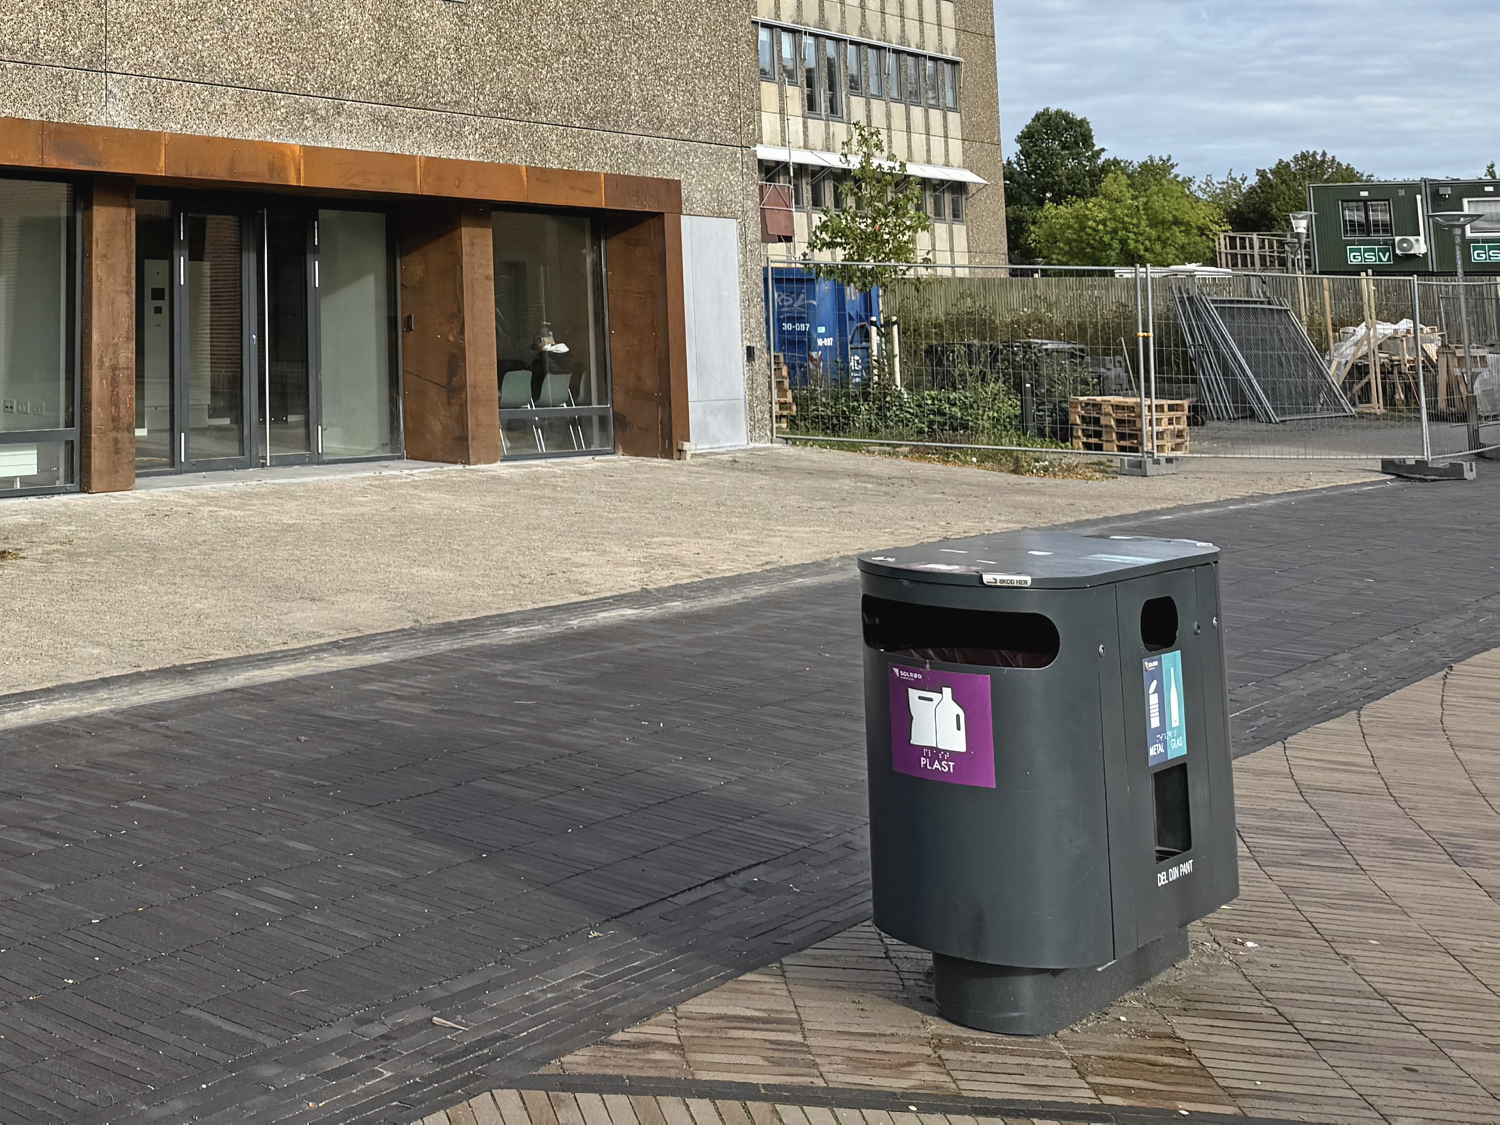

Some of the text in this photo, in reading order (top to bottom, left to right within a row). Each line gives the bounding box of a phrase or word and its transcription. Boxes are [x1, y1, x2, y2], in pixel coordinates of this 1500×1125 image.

[1350, 251, 1390, 262] GSV
[1149, 742, 1165, 757] METAL
[1170, 735, 1183, 750] GLAS
[920, 756, 956, 773] PLAST
[1157, 871, 1169, 887] DEL
[1179, 859, 1194, 877] PANT
